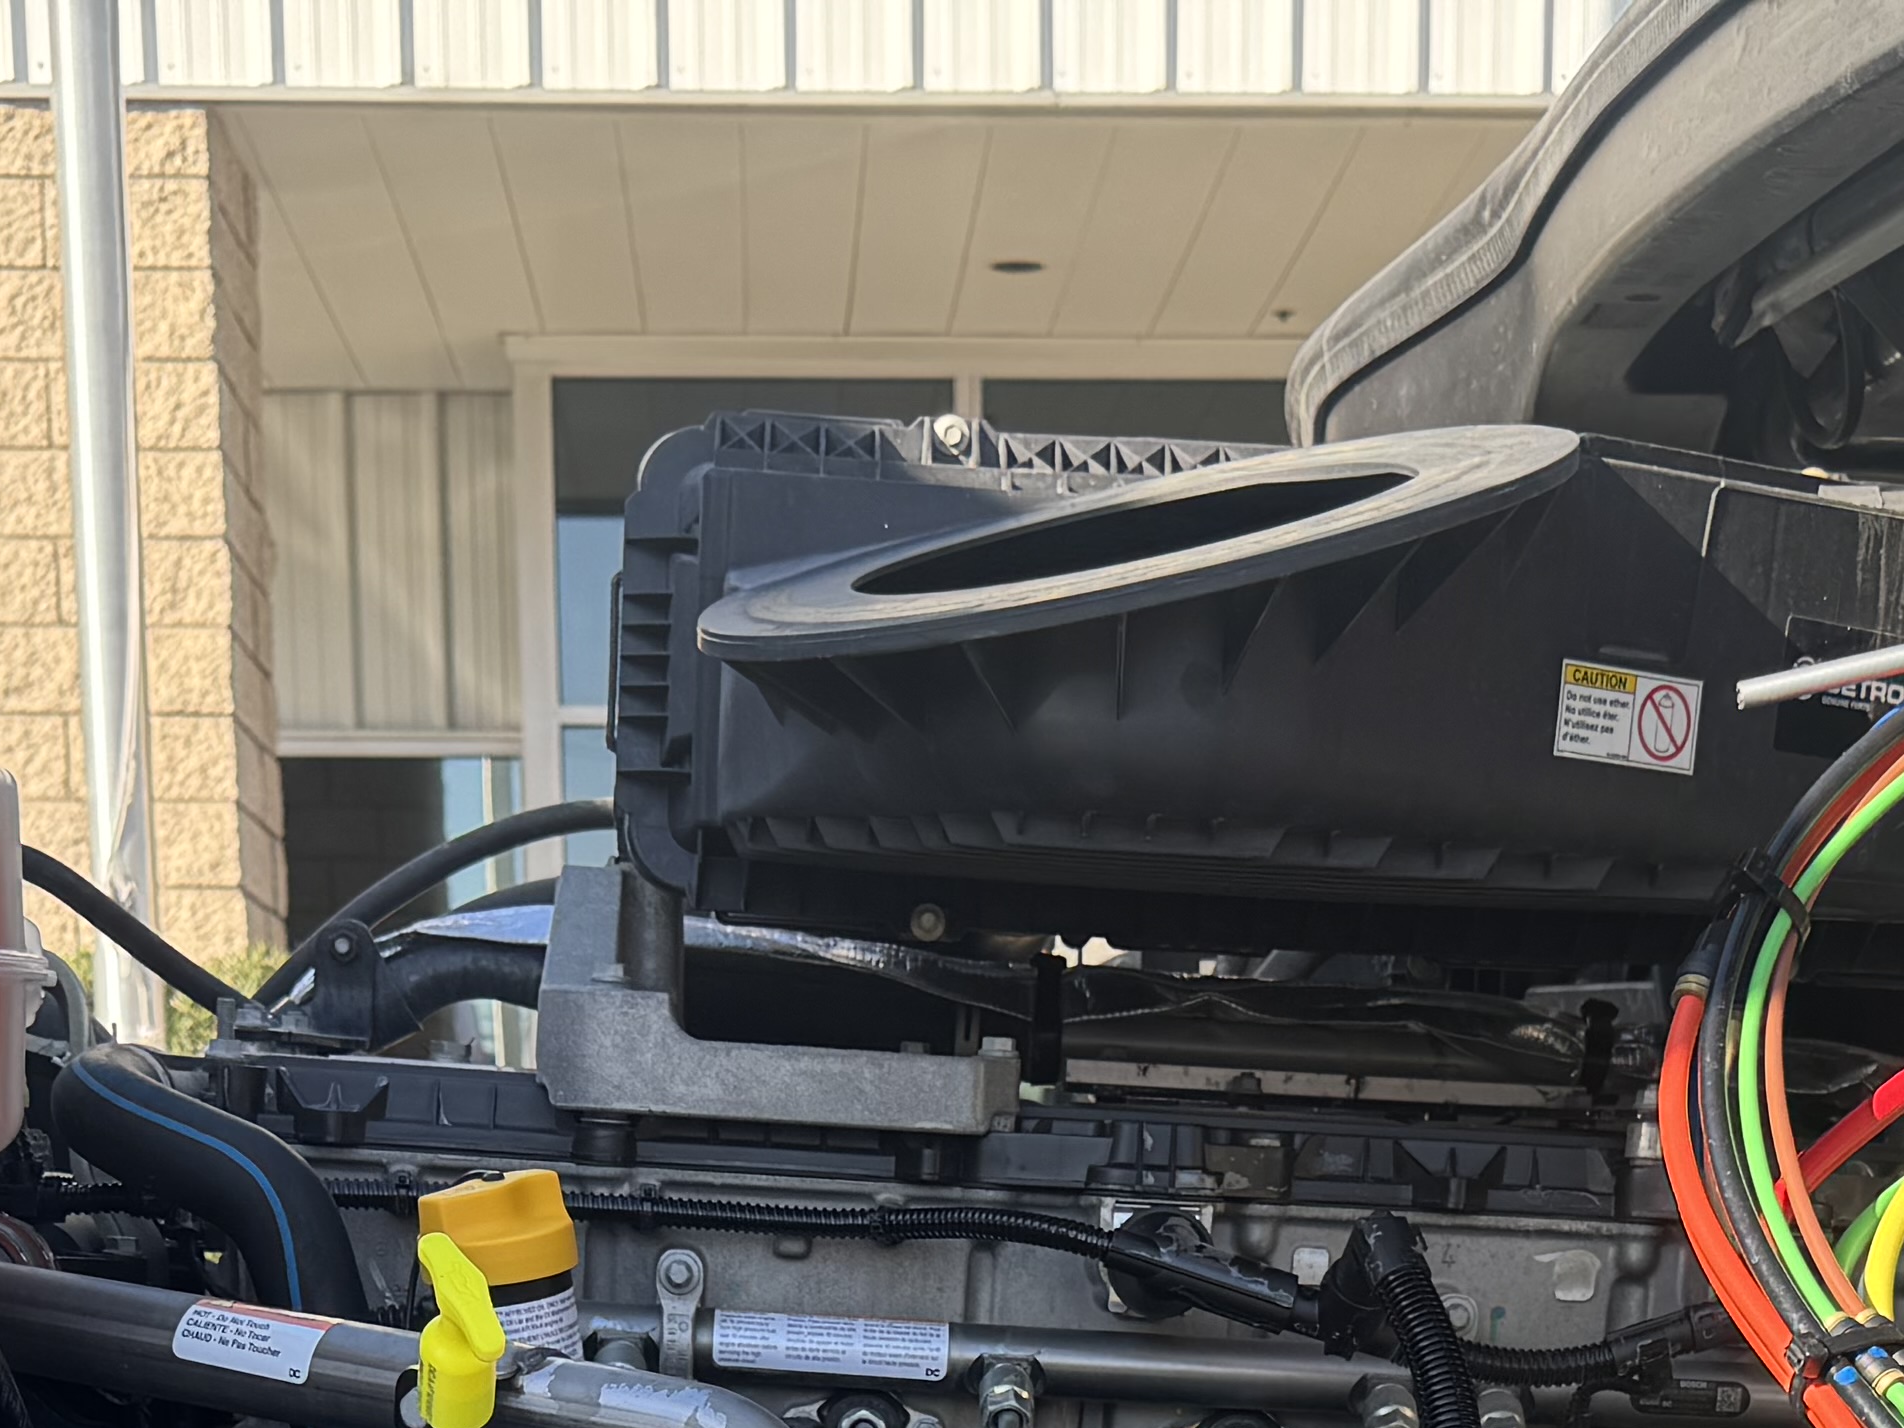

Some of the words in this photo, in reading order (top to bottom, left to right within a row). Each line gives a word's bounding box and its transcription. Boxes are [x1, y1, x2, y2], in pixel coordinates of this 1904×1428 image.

[1573, 669, 1627, 690] CAUTION
[1567, 691, 1577, 700] Do
[1594, 697, 1607, 705] use
[1565, 705, 1575, 713] No
[192, 1310, 211, 1319] HOT
[186, 1318, 227, 1334] CALIENTE
[181, 1330, 212, 1342] CHAUD
[289, 1368, 300, 1378] DC
[925, 1368, 940, 1377] DC
